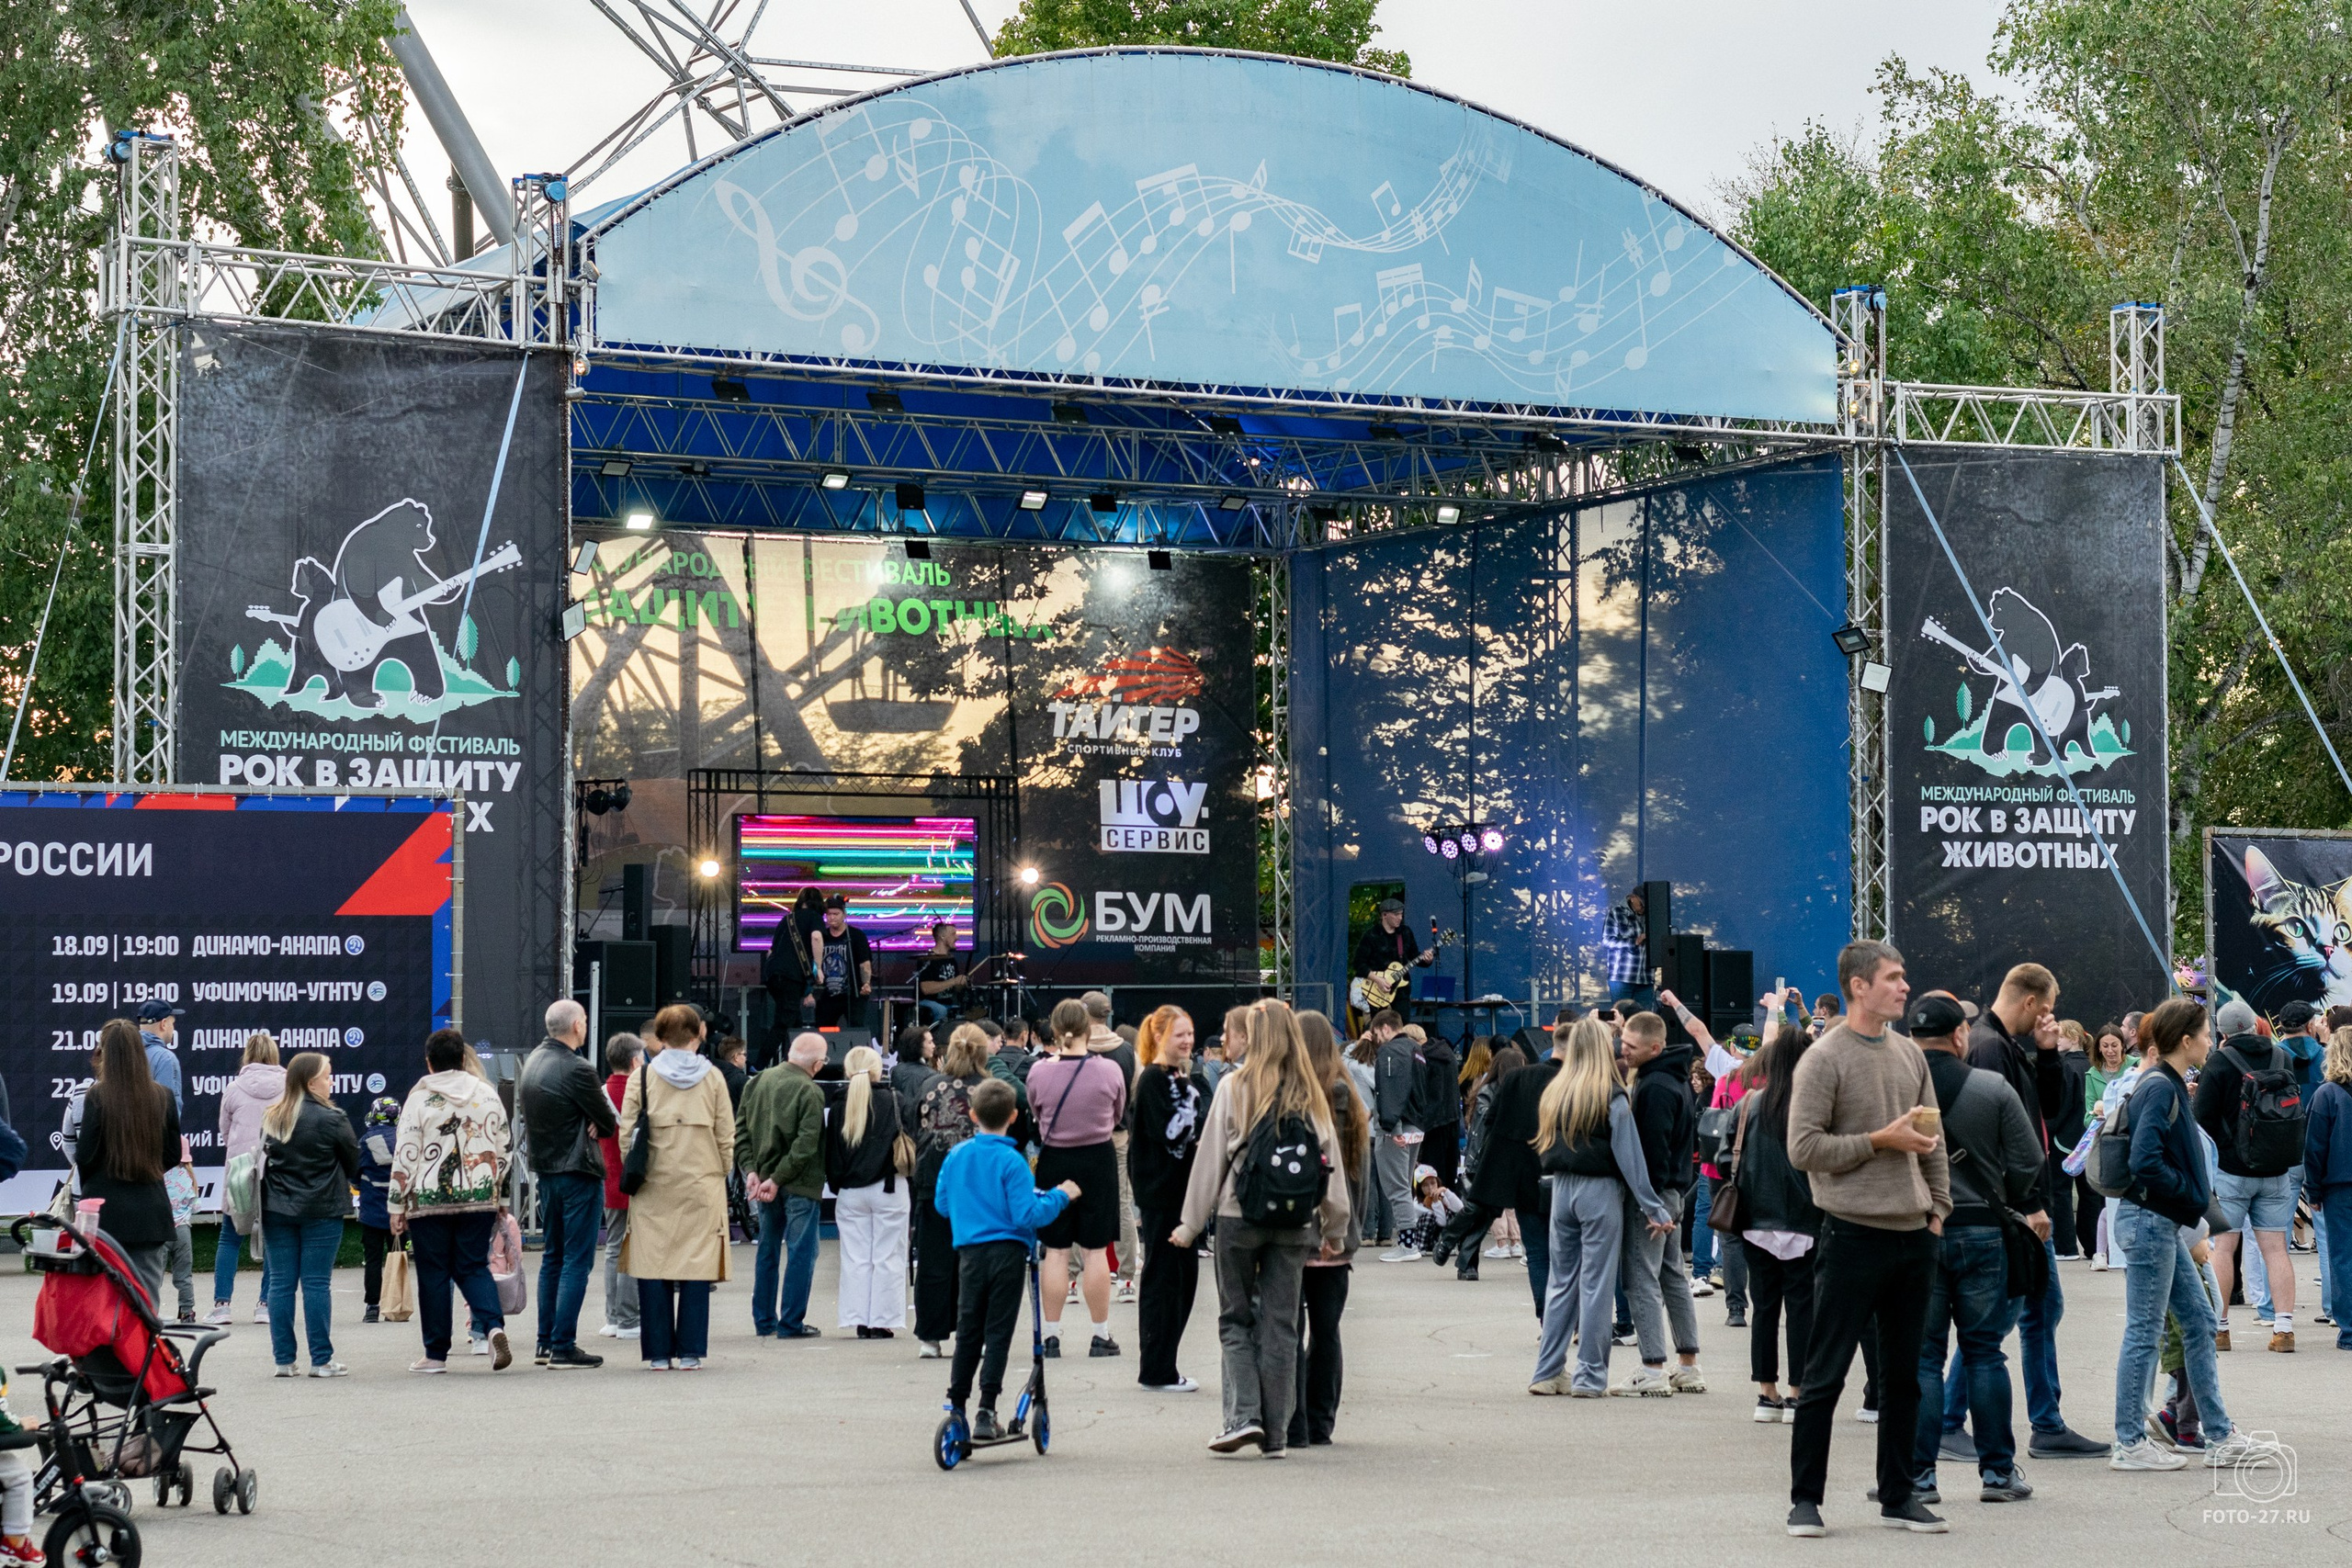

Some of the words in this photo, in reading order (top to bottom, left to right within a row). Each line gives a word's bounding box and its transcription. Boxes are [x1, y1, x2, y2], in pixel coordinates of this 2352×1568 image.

[1046, 693, 1201, 743] ТАЙГЕР
[220, 729, 403, 753] МЕЖДУНАРОДНЫЙ
[408, 735, 521, 755] ФЕСТИВАЛЬ
[1067, 743, 1148, 757] СПОРТИВНЫЙ
[1151, 747, 1182, 758] КЛУБ
[220, 754, 304, 786] РОК
[348, 757, 522, 792] ЗАЩИТУ
[1921, 784, 2053, 804] МЕЖДУНАРОДНЫЙ
[1920, 806, 1983, 833] РОК
[2014, 807, 2137, 838] ЗАЩИТУ
[1106, 829, 1205, 851] СЕРВИС
[1941, 840, 2120, 869] ЖИВОТНЫХ
[1095, 891, 1212, 933] БУМ
[51, 935, 108, 956] 18.09
[123, 935, 180, 956] 19:00
[192, 935, 341, 957] ДИНАМО-АНАПА
[1095, 935, 1213, 945] РЕКЛАМНО-ПРОИЗВОДСТВЕННАЯ
[1134, 944, 1176, 953] КОМПАНИЯ
[51, 982, 108, 1003] 19.09
[122, 982, 180, 1003] 19:00
[192, 982, 364, 1002] УФИМОЧКА-УГНТУ
[191, 1028, 341, 1051] ДИНАМ-АНАПА
